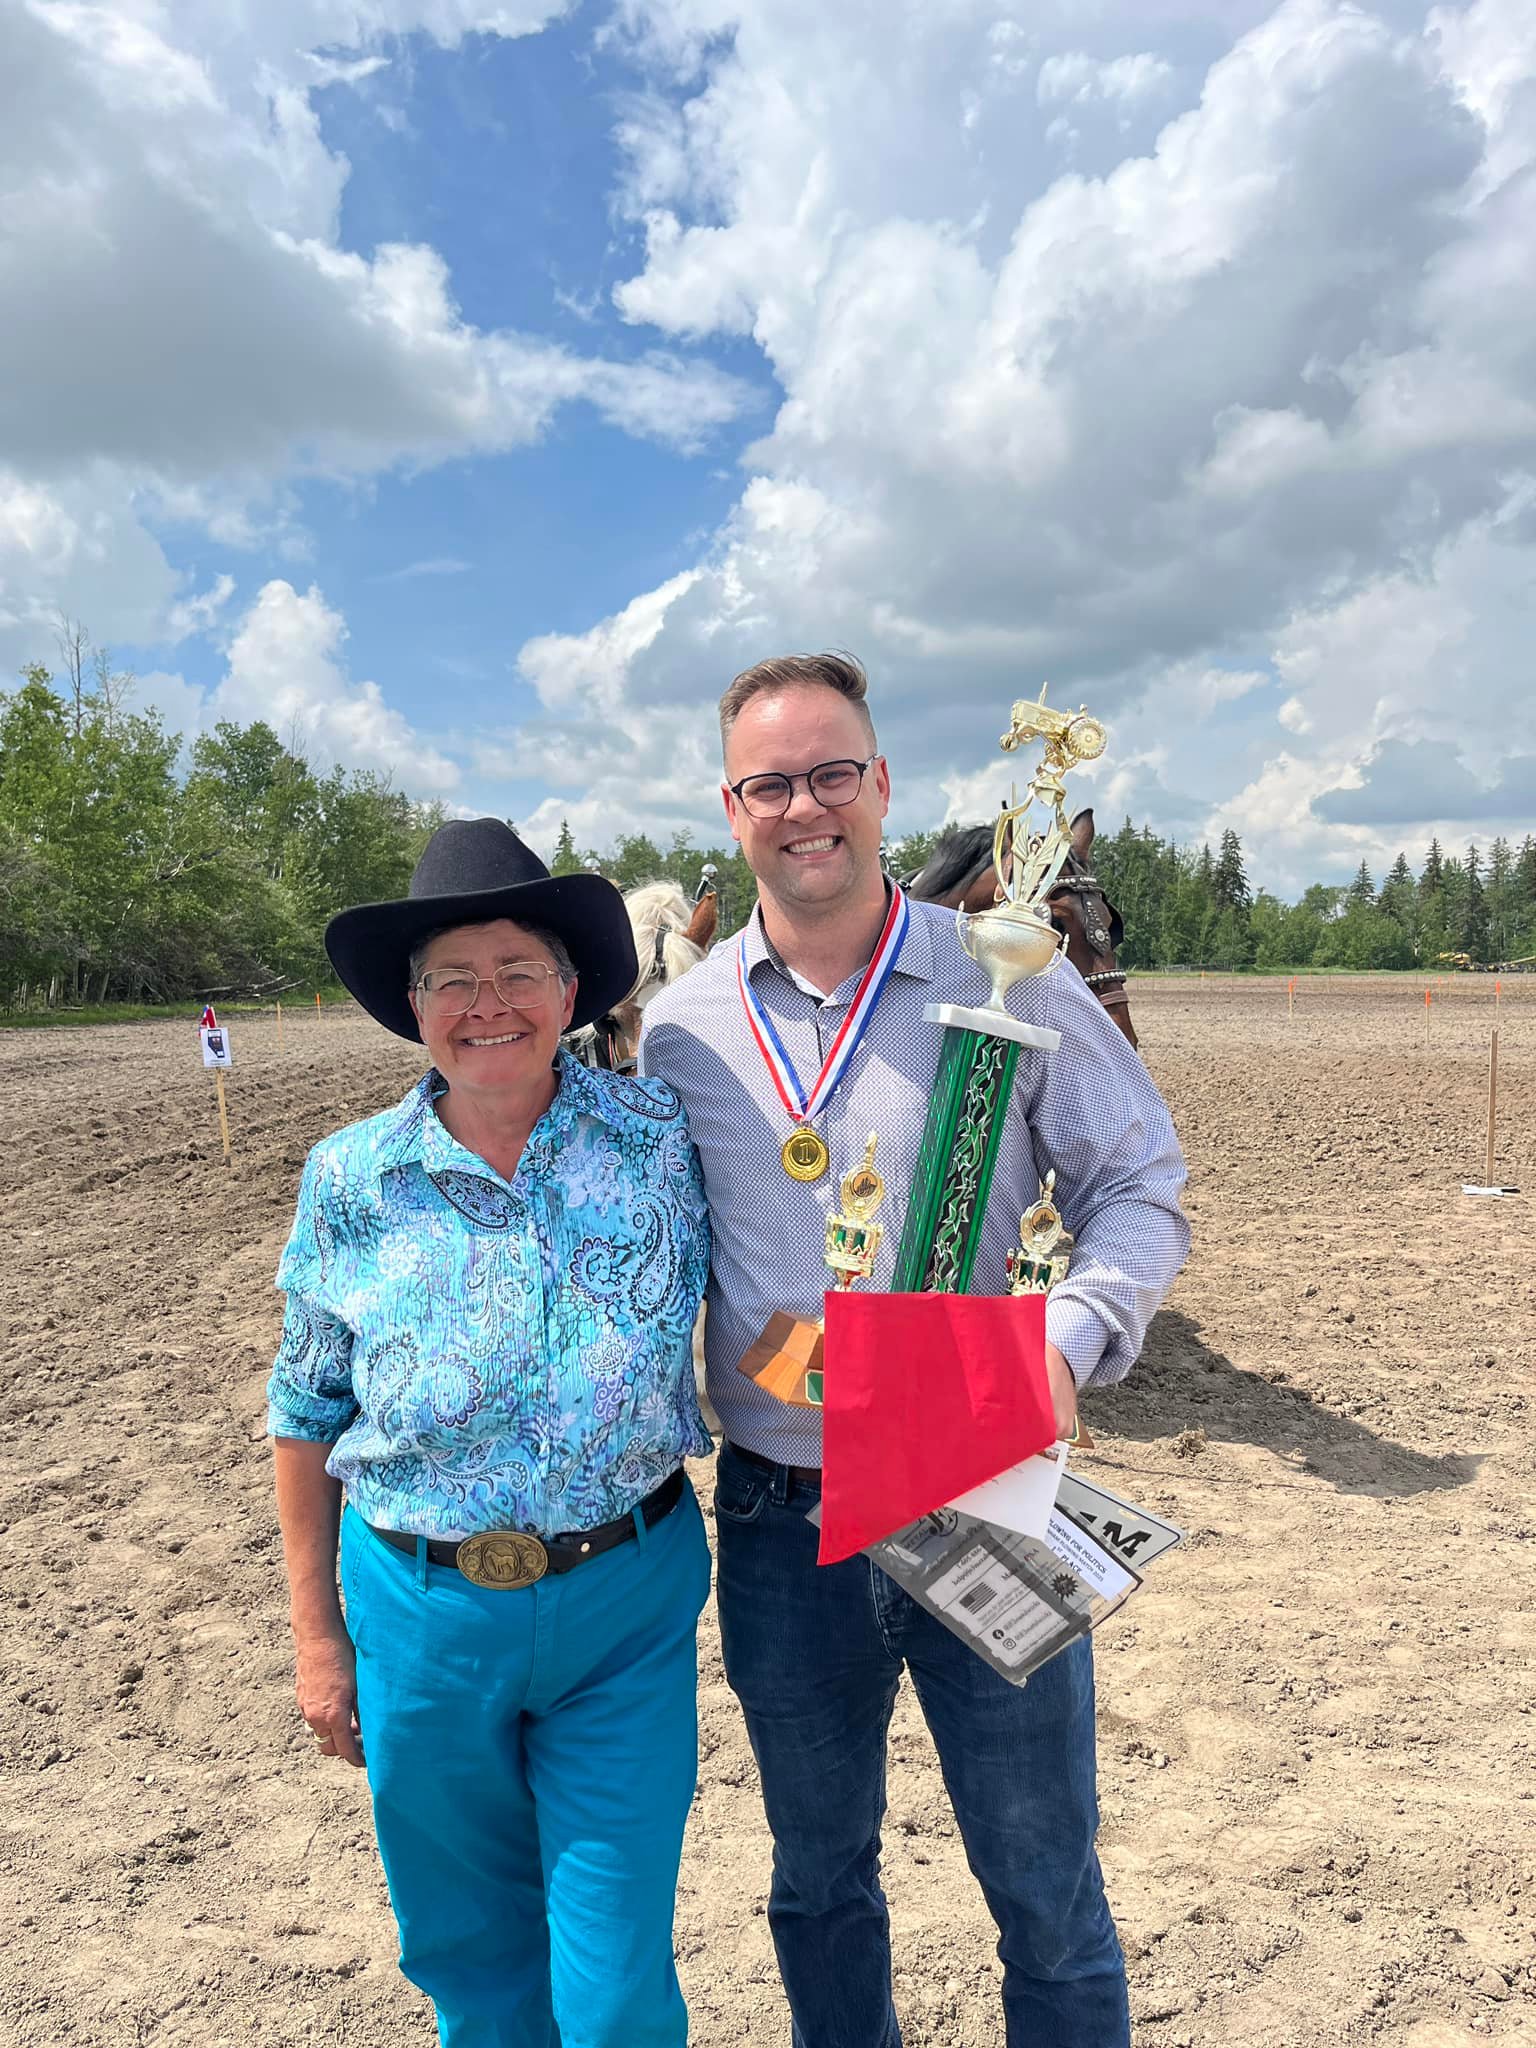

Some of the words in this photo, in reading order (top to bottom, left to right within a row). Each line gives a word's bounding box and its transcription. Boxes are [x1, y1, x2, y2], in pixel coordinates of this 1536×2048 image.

[799, 1142, 811, 1164] 1
[1070, 1539, 1083, 1552] FOR
[1081, 1550, 1107, 1574] POLITICS
